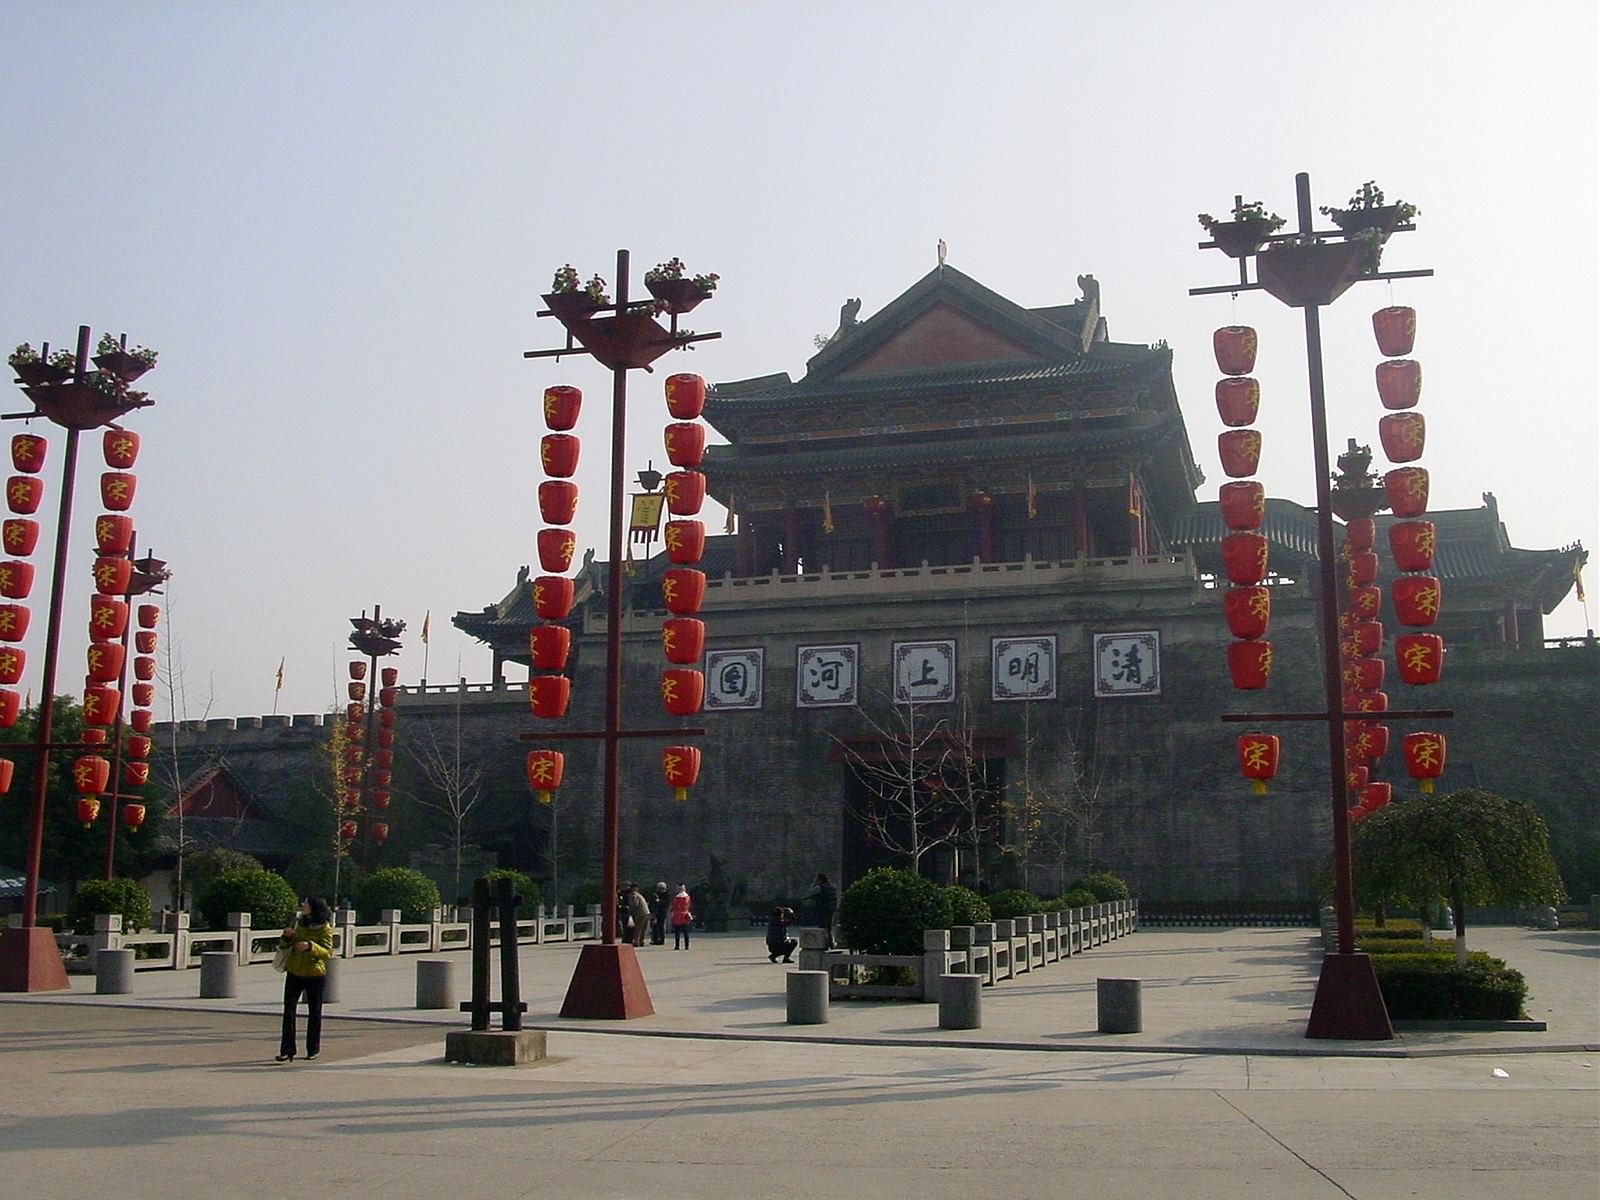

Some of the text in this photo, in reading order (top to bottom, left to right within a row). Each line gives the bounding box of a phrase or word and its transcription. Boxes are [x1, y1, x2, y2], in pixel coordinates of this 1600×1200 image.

[14, 438, 34, 460] 宋
[112, 437, 133, 459] 宋
[10, 482, 32, 504] 宋
[107, 479, 128, 501] 宋
[6, 523, 25, 545] 宋
[97, 520, 115, 542] 宋
[97, 564, 117, 587] 宋
[1248, 591, 1270, 620] 宋
[1415, 586, 1439, 616] 宋
[94, 607, 115, 629] 宋
[88, 649, 104, 671] 宋
[1008, 651, 1039, 684] 明
[1112, 643, 1143, 685] 清
[1404, 643, 1432, 673] 宋
[810, 657, 844, 690] 河
[910, 658, 939, 687] 上
[84, 694, 100, 716] 宋
[1243, 741, 1270, 771] 宋
[1413, 739, 1441, 769] 宋
[73, 765, 93, 787] 宋
[531, 757, 555, 784] 宋
